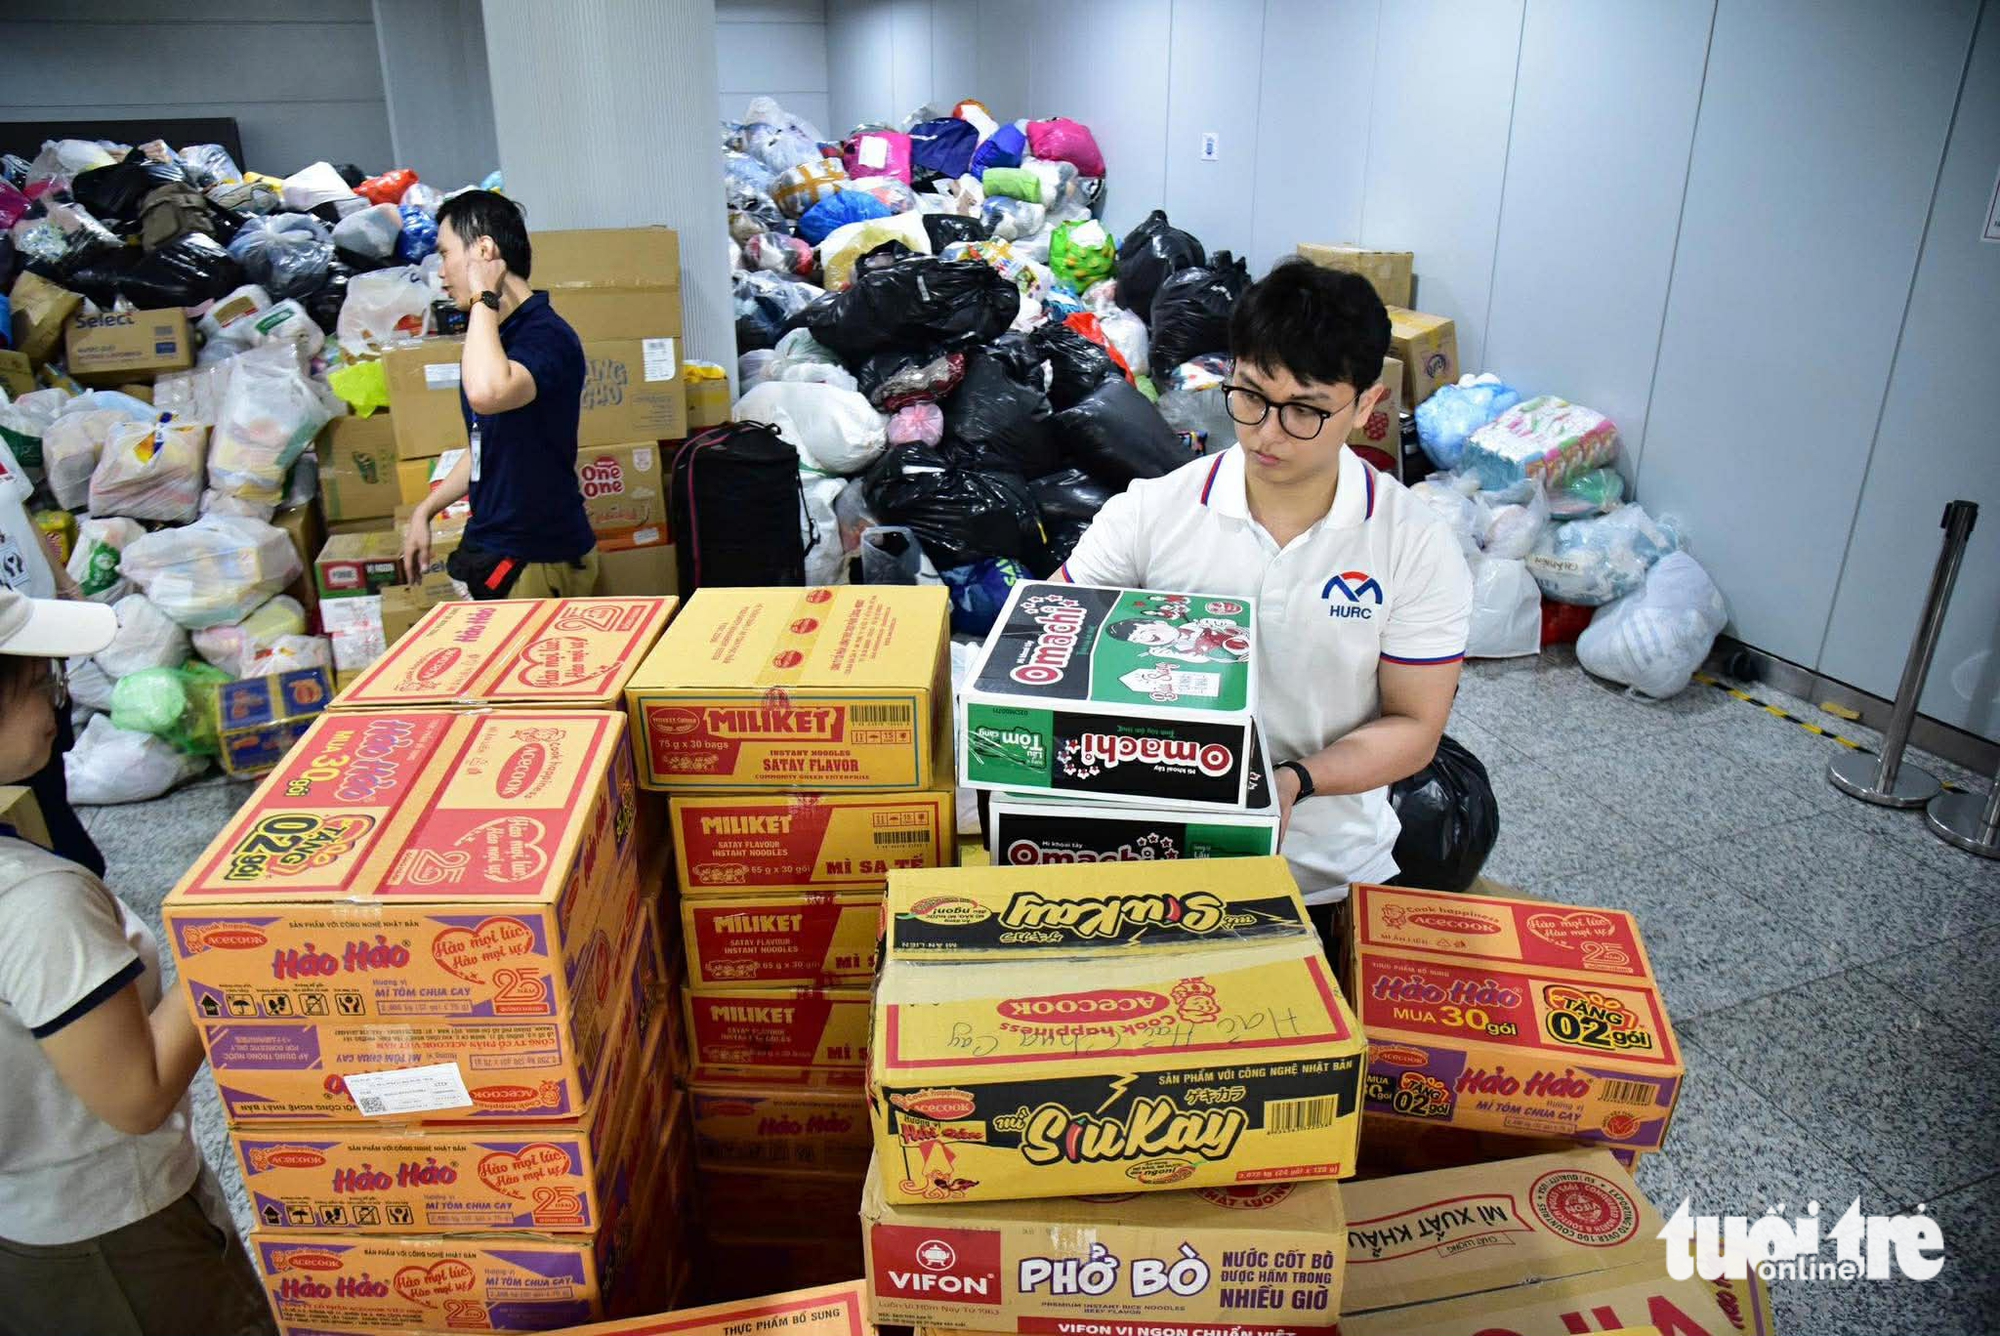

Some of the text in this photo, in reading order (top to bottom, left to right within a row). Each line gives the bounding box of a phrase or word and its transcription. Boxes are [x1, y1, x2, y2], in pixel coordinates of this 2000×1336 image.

[581, 466, 621, 481] One
[583, 480, 623, 497] One
[1330, 605, 1372, 619] HURC
[1010, 606, 1087, 686] Omachi
[708, 709, 831, 733] MILIKET
[659, 740, 671, 748] 75
[673, 742, 679, 750] g
[690, 740, 702, 748] 30
[704, 740, 729, 750] bags
[1001, 729, 1042, 750] Tôm
[284, 729, 358, 798] MUA 30 gói
[763, 759, 860, 772] SATAY FLAVOR
[1081, 733, 1234, 778] Omachi
[1153, 764, 1166, 773] tây
[1166, 766, 1187, 774] khoai
[233, 813, 323, 856] 02
[701, 814, 792, 835] MILIKET
[712, 849, 789, 857] INSTANT NOODLES
[718, 841, 780, 849] SATAY FLAVOUR
[751, 866, 763, 874] 65
[765, 867, 771, 875] g
[825, 858, 852, 875] MÌ
[859, 860, 887, 874] SA
[1406, 905, 1436, 914] Cook
[289, 921, 304, 929] SẢN
[713, 913, 803, 933] MILIKET
[272, 934, 411, 981] Hảo Hảo
[1580, 940, 1630, 967] 25
[374, 986, 391, 997] MÌ
[393, 985, 417, 997] TÔM
[450, 986, 472, 996] CAY
[491, 967, 549, 1004] 25
[1372, 974, 1522, 1009] Hảo Hảo
[710, 1006, 796, 1024] MILIKET
[1000, 1014, 1178, 1039] Cook happiness
[1393, 1004, 1518, 1036] MUA 30 gói
[1549, 1010, 1651, 1048] 02 gói
[1158, 1058, 1353, 1086] SẢN PHẨM VỚI CÔNG NGHỆ NHẬT BẢN
[1366, 1074, 1390, 1086] MUA
[1455, 1064, 1591, 1099] Hảo Hảo
[1184, 1085, 1247, 1106] ゲキカラ
[1394, 1089, 1452, 1117] 02 gói
[1475, 1100, 1492, 1111] MÌ
[1557, 1111, 1583, 1122] CAY
[332, 1156, 458, 1194] Hảo Hảo
[532, 1186, 581, 1214] 25
[1347, 1204, 1508, 1259] MÌ XUẤT KHẨU
[1017, 1241, 1211, 1298] PHỞ BÒ
[1222, 1247, 1334, 1270] NƯỚC CỐT BÒ
[281, 1272, 389, 1299] Hảo Hảo
[888, 1270, 989, 1296] VIFON
[1220, 1268, 1332, 1285] ĐƯỢC HẦM TRONG
[1219, 1284, 1329, 1310] NHIỀU GIỜ
[443, 1299, 488, 1323] 25
[722, 1307, 841, 1336] THỰC PHẨM BỔ SUNG
[1058, 1322, 1113, 1334] VIFON
[1137, 1327, 1189, 1336] NGON
